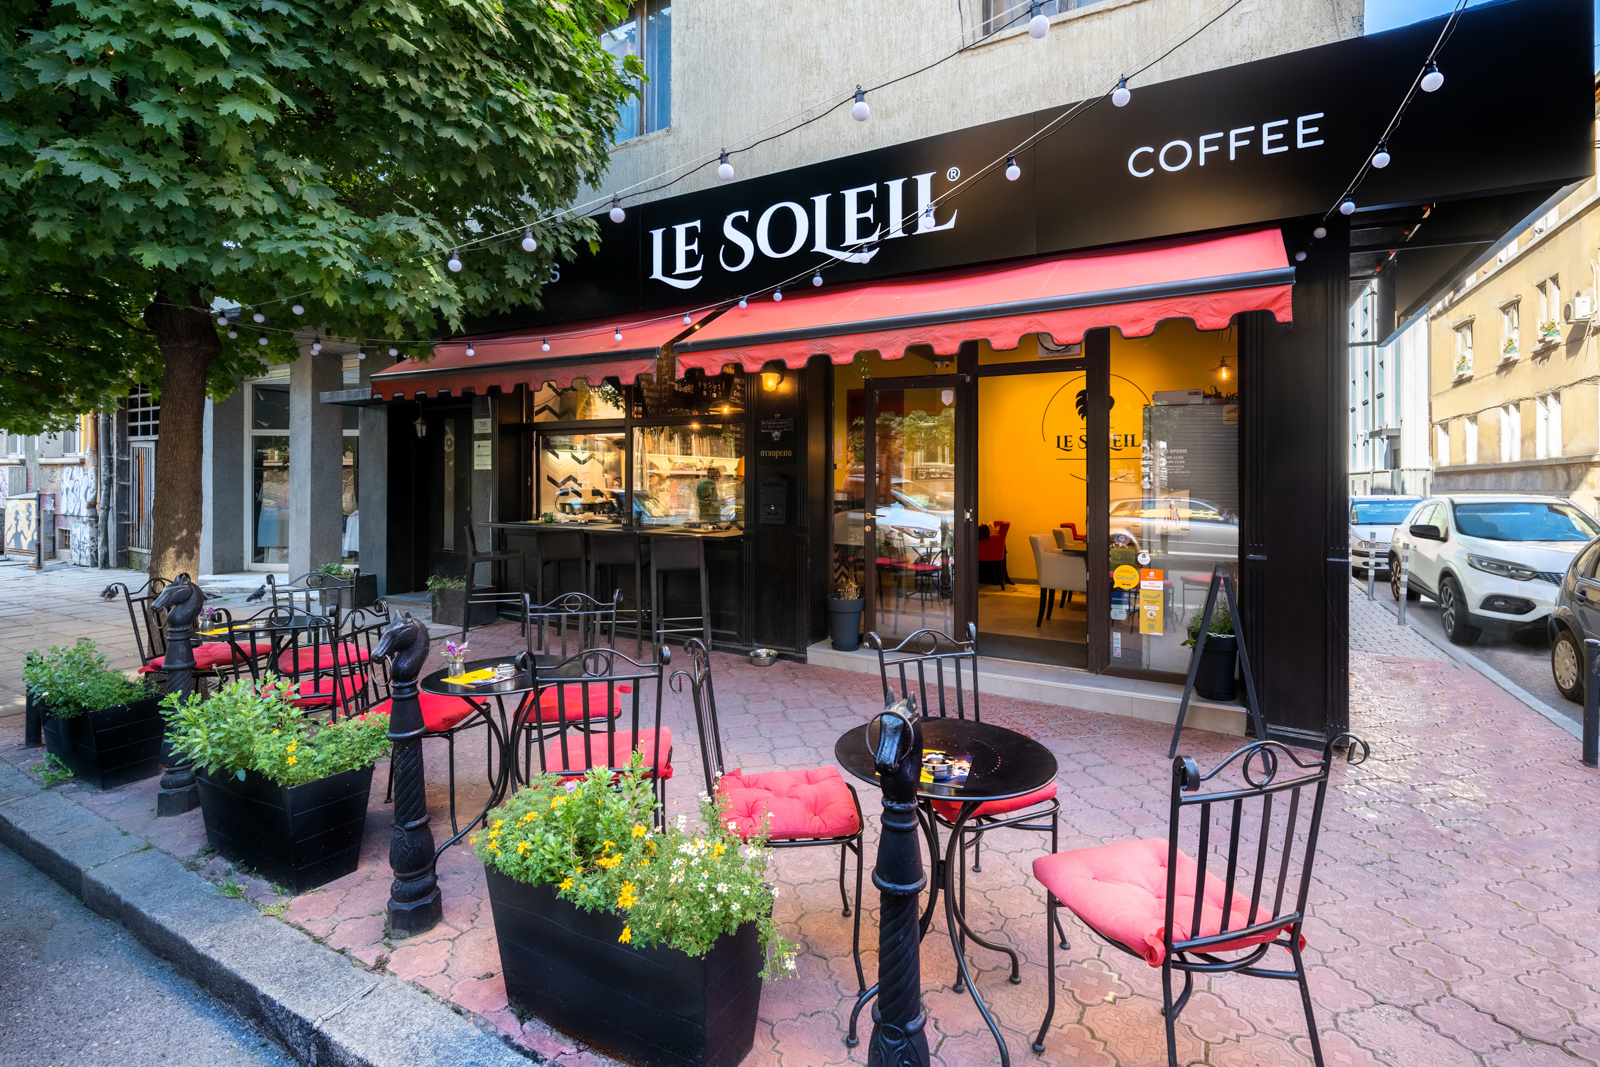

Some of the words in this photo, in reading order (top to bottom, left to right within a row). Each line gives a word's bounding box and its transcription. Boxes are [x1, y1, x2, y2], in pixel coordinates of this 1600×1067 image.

[1128, 112, 1324, 178] COFFEE
[649, 219, 704, 290] LE
[719, 171, 958, 264] SOLEIL
[1056, 435, 1073, 451] LE
[1078, 434, 1141, 451] SEIL
